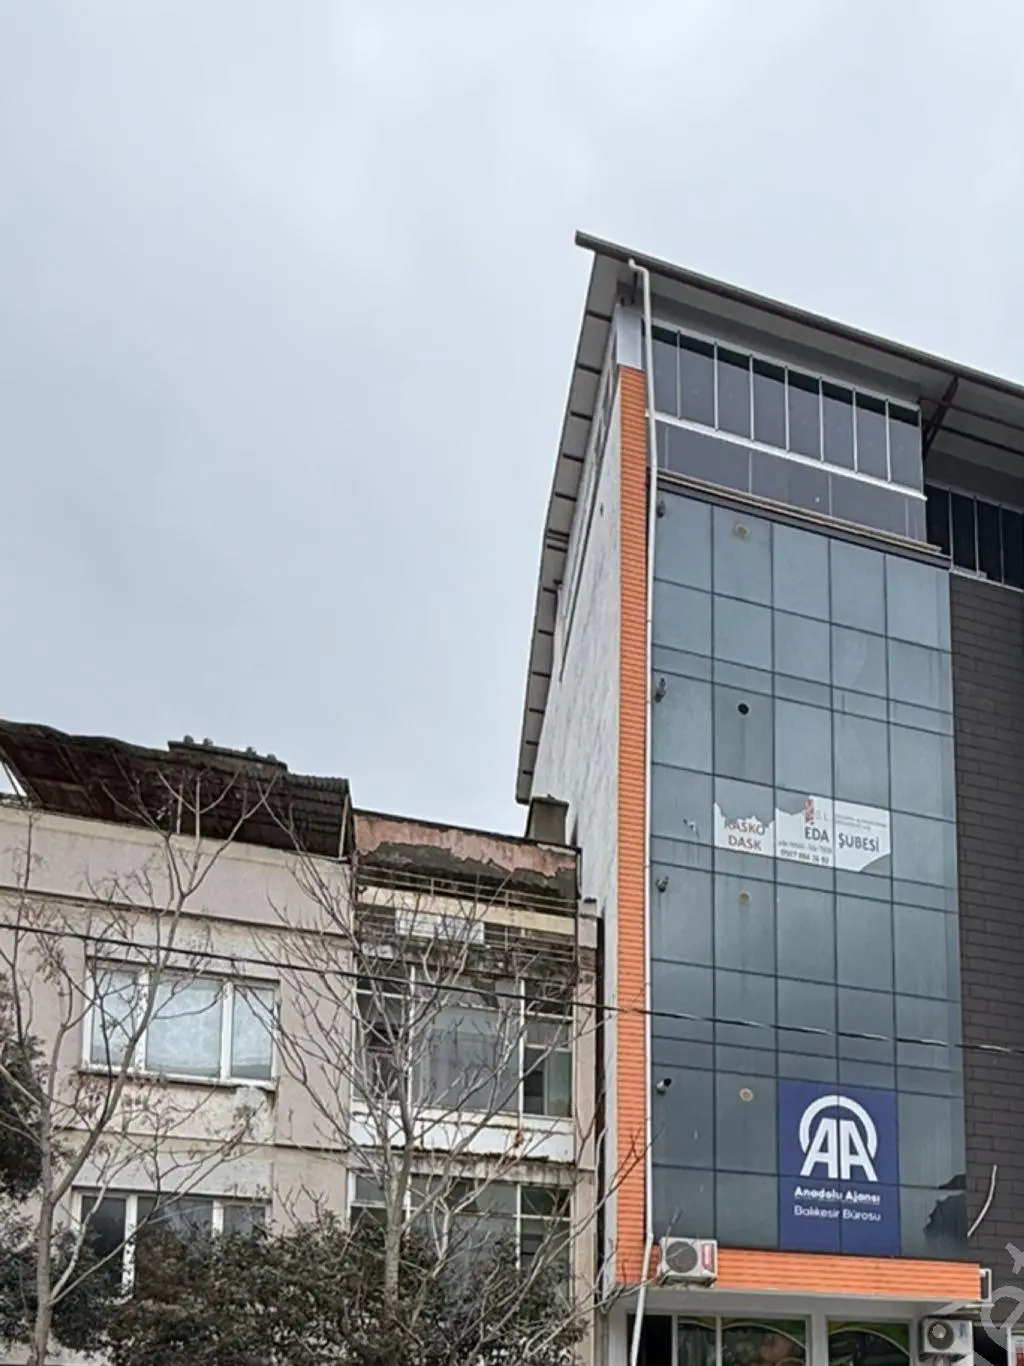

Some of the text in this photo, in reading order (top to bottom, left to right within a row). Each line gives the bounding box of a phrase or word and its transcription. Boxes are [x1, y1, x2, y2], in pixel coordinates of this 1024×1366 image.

[728, 836, 762, 851] DASK
[805, 827, 829, 843] EDA
[838, 833, 880, 852] ŞUBESİ
[800, 1117, 878, 1182] AA
[794, 1186, 842, 1201] Anadolu
[843, 1208, 881, 1221] Bürosu
